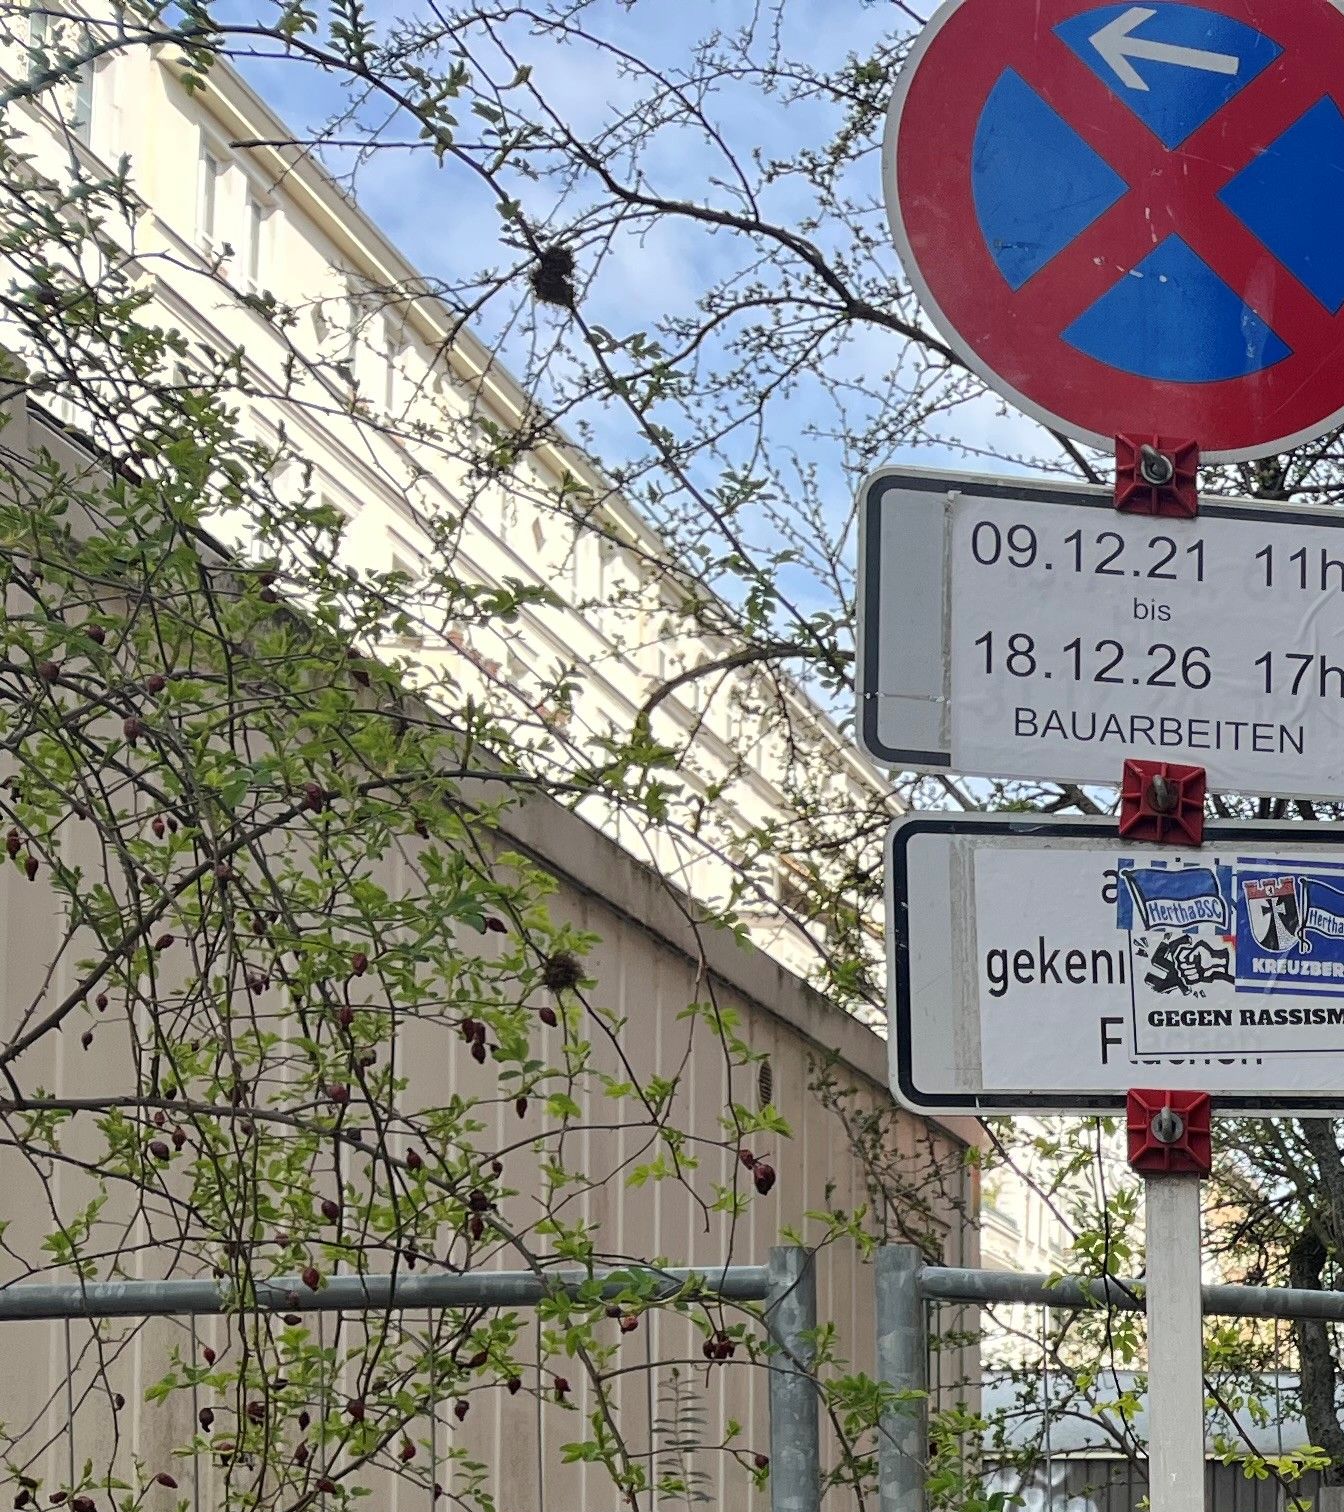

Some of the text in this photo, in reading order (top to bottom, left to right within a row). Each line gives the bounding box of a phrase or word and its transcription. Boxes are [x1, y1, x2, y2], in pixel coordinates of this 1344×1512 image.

[970, 520, 1207, 583] 09.12.21
[1132, 597, 1172, 622] bis
[974, 630, 1213, 690] 18.12.26
[1014, 707, 1305, 755] BAUARBEITEN
[1147, 1009, 1233, 1028] GEGEN
